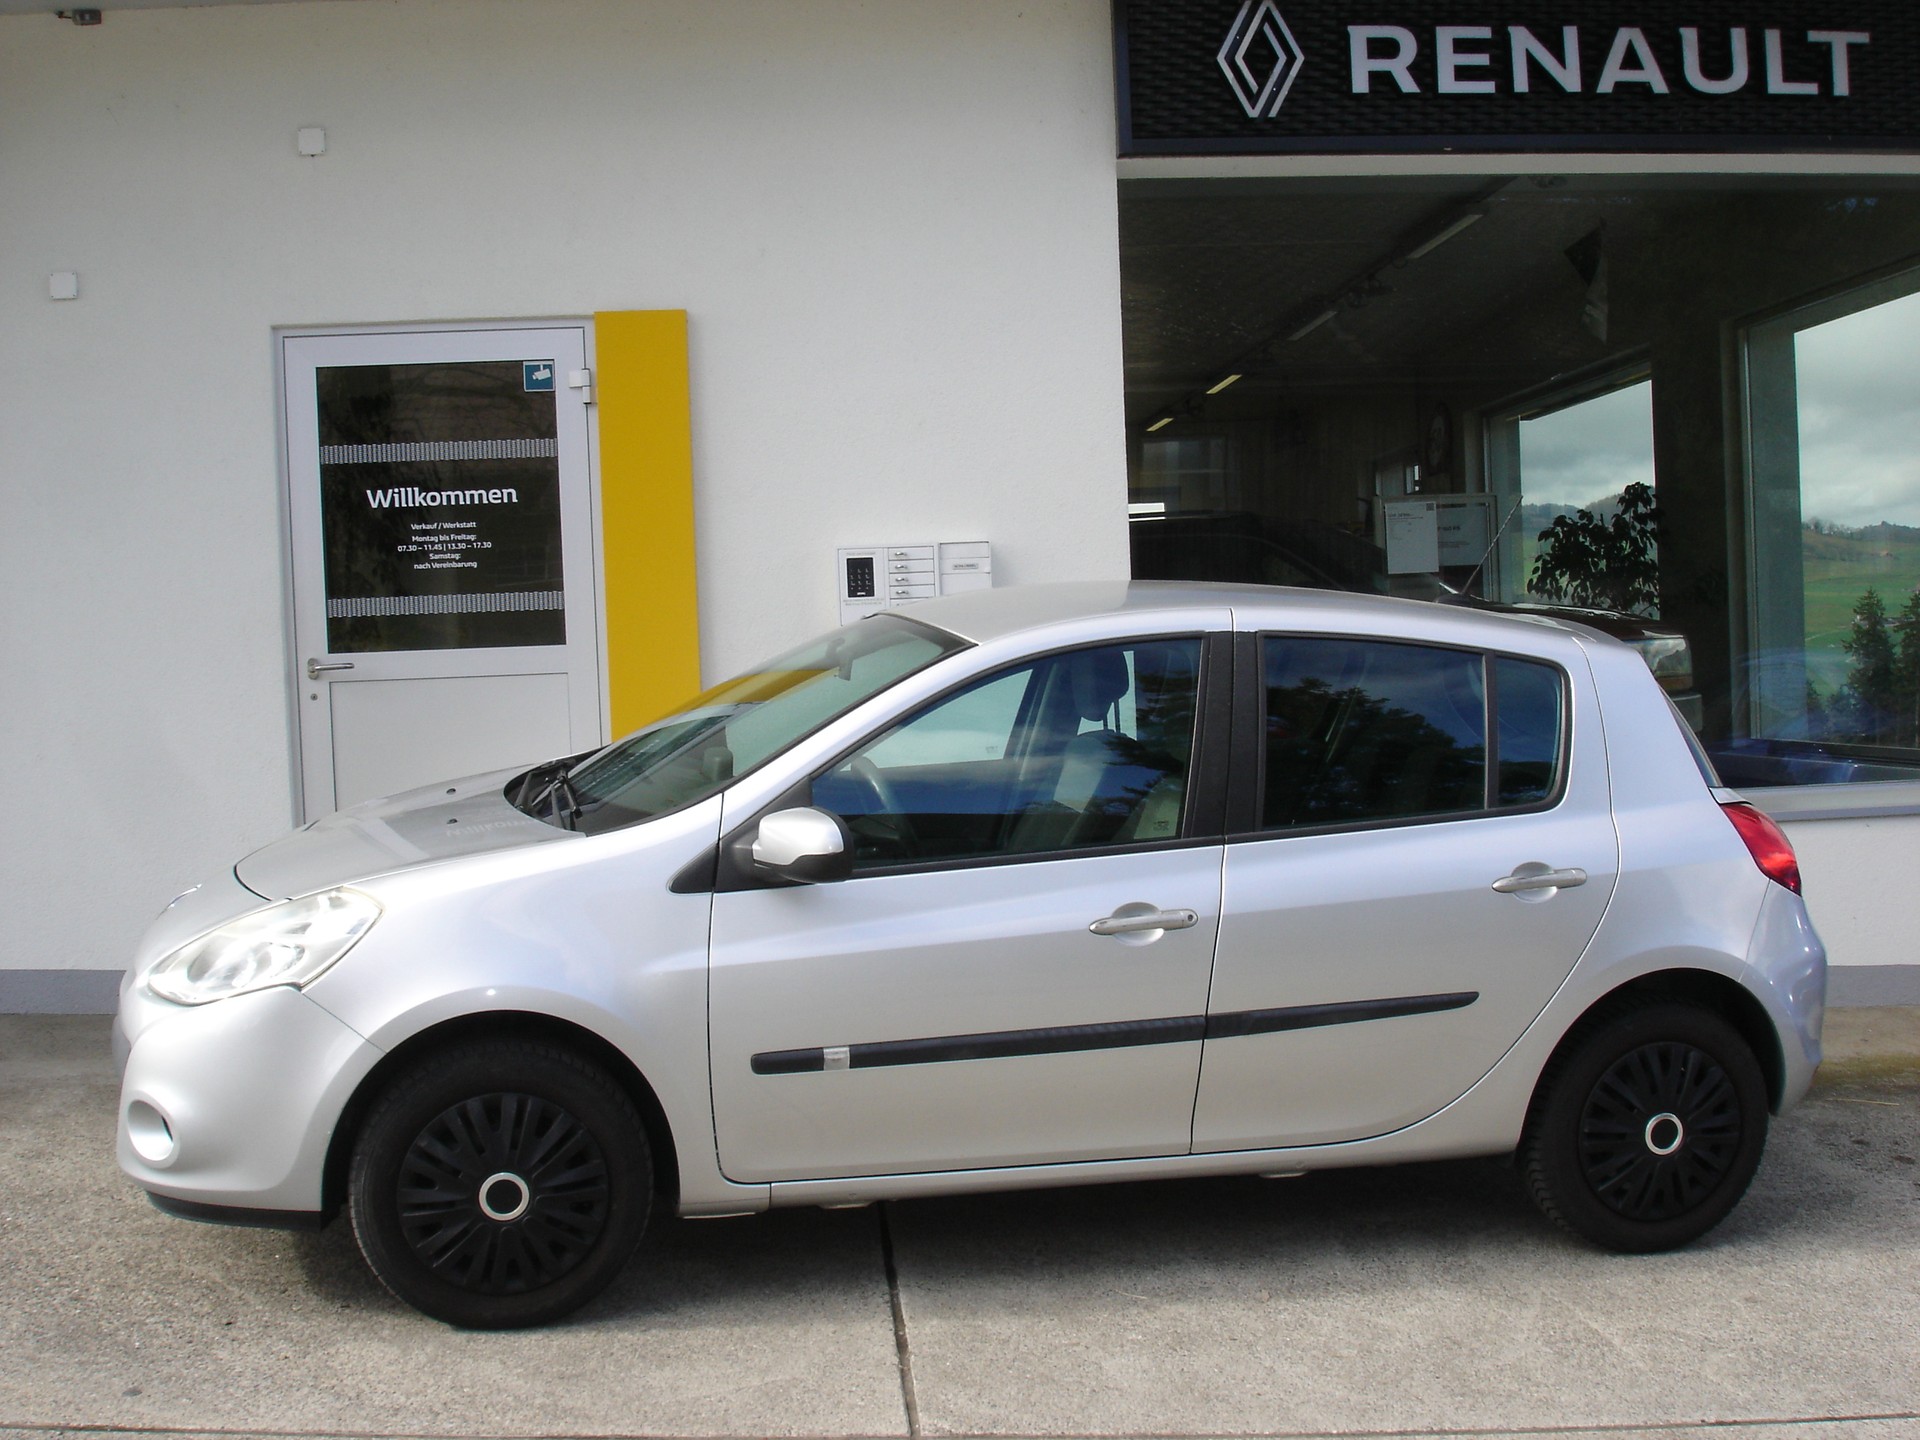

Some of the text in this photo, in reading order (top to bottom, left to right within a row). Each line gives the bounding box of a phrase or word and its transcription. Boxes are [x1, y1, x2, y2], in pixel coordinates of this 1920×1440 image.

[1347, 25, 1870, 97] RENAULT
[366, 487, 518, 508] Willkommen
[411, 522, 437, 530] Verkauf
[442, 521, 477, 529] Werkstatt
[412, 535, 438, 543] Montag
[450, 533, 477, 541] Freitag:
[424, 543, 442, 551] 11.45
[473, 541, 492, 549] 17.30
[429, 552, 461, 560] Samstag:
[431, 561, 478, 569] Vereinbarung
